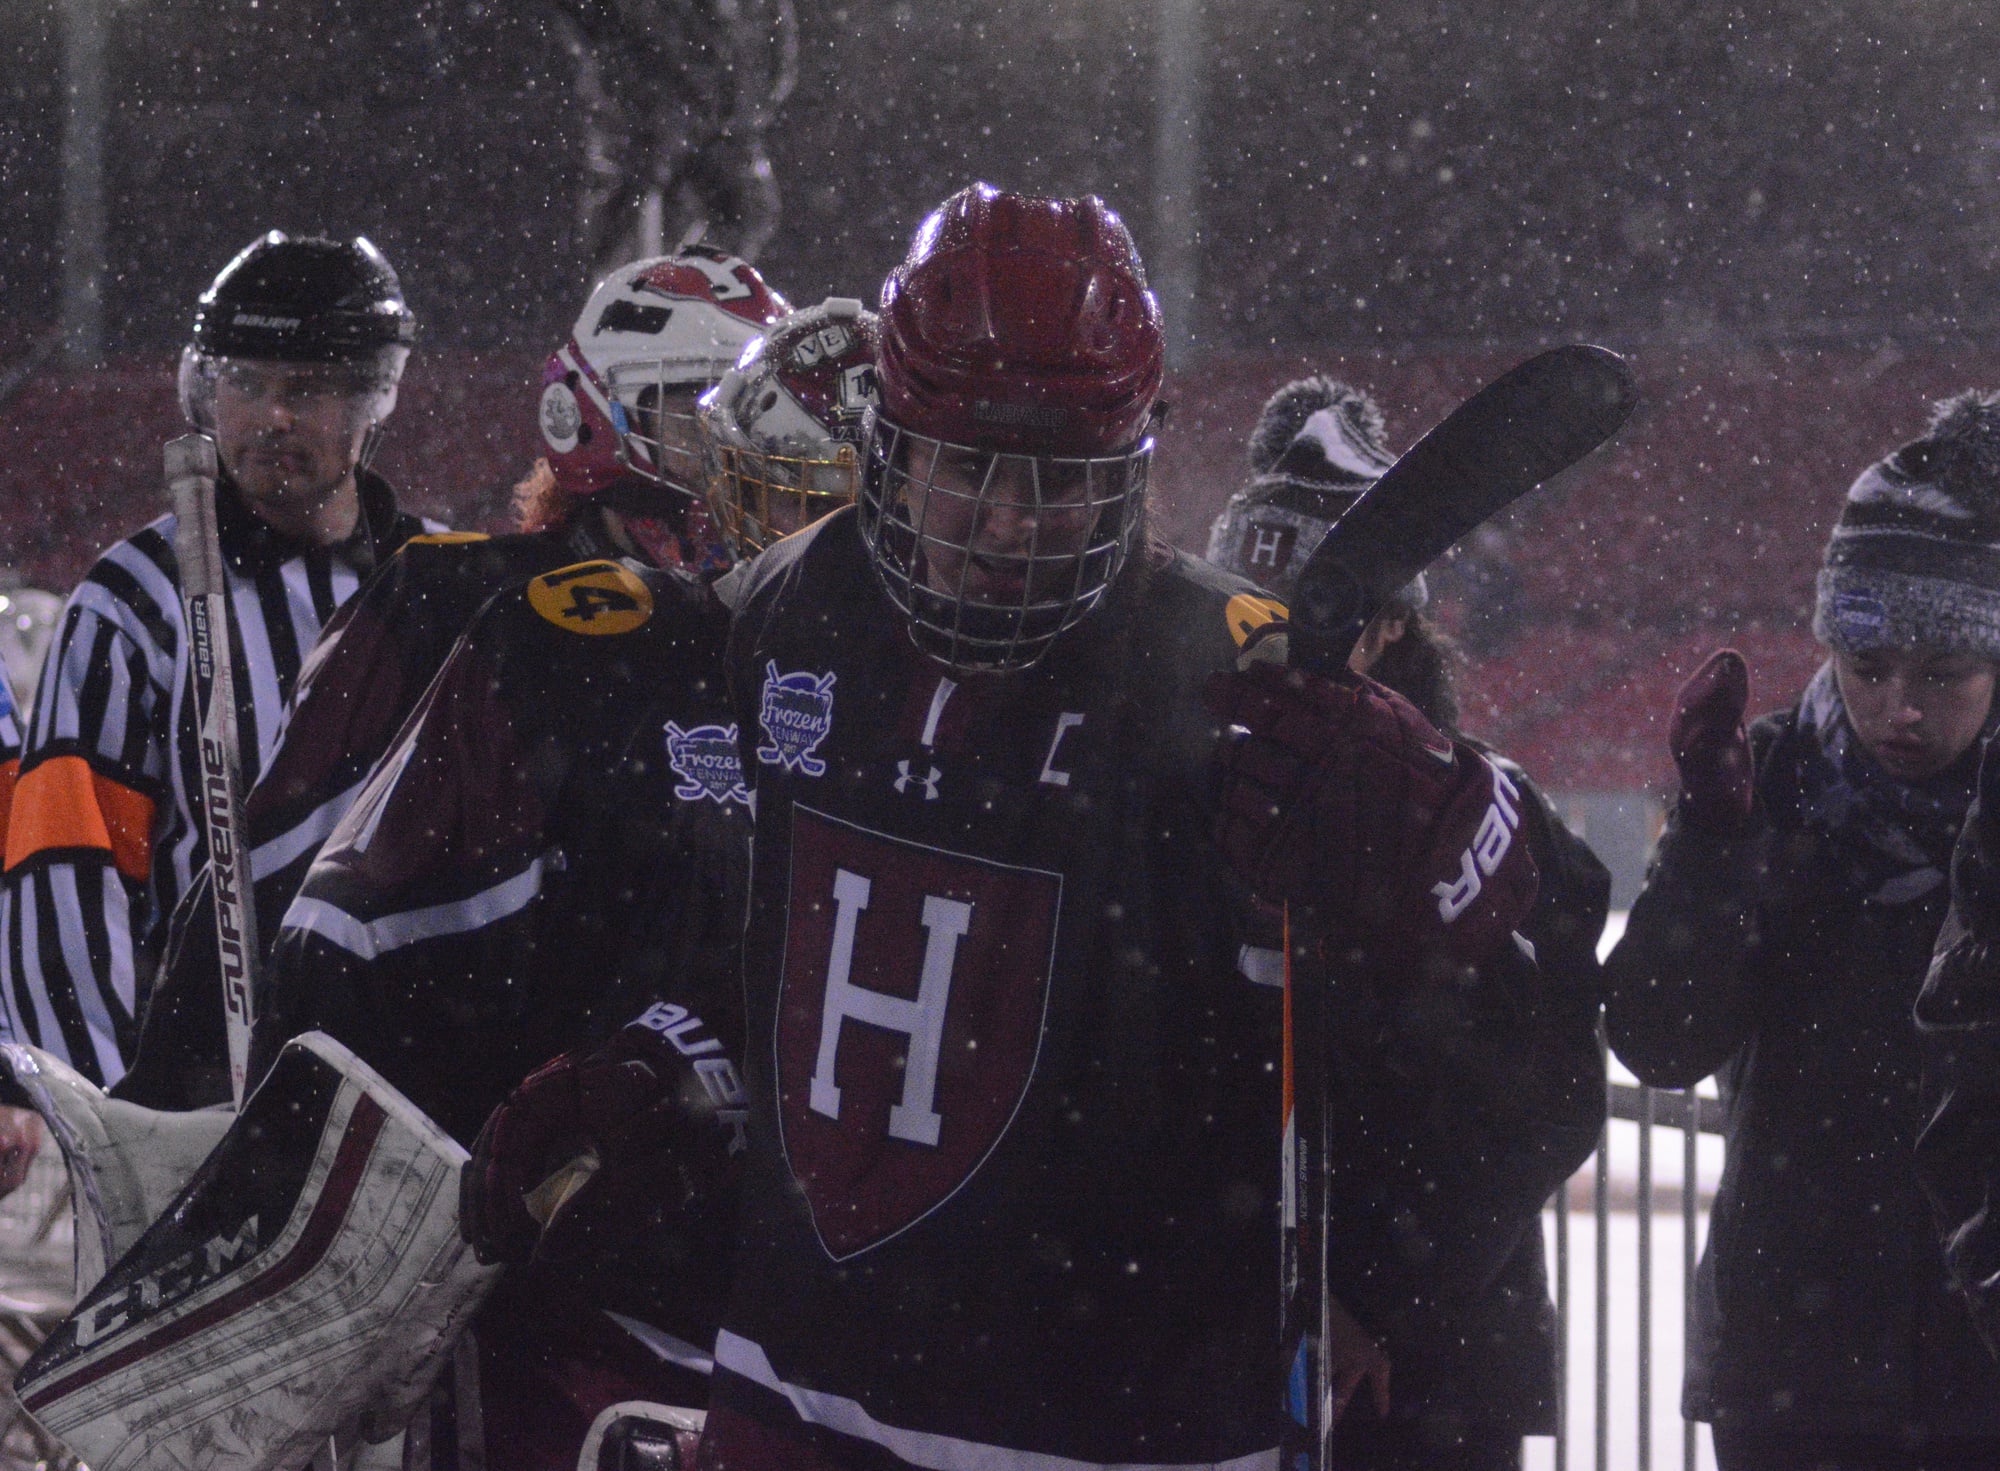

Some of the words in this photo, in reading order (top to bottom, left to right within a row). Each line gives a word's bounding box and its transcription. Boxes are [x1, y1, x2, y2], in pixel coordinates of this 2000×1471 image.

[1251, 528, 1282, 566] H
[542, 563, 639, 621] 14
[195, 600, 211, 679] BAUER
[763, 692, 825, 732] Frozen
[1039, 712, 1086, 786] C
[202, 738, 249, 1026] SUPREME
[809, 868, 972, 1146] H
[1299, 1136, 1308, 1181] MINIMUS
